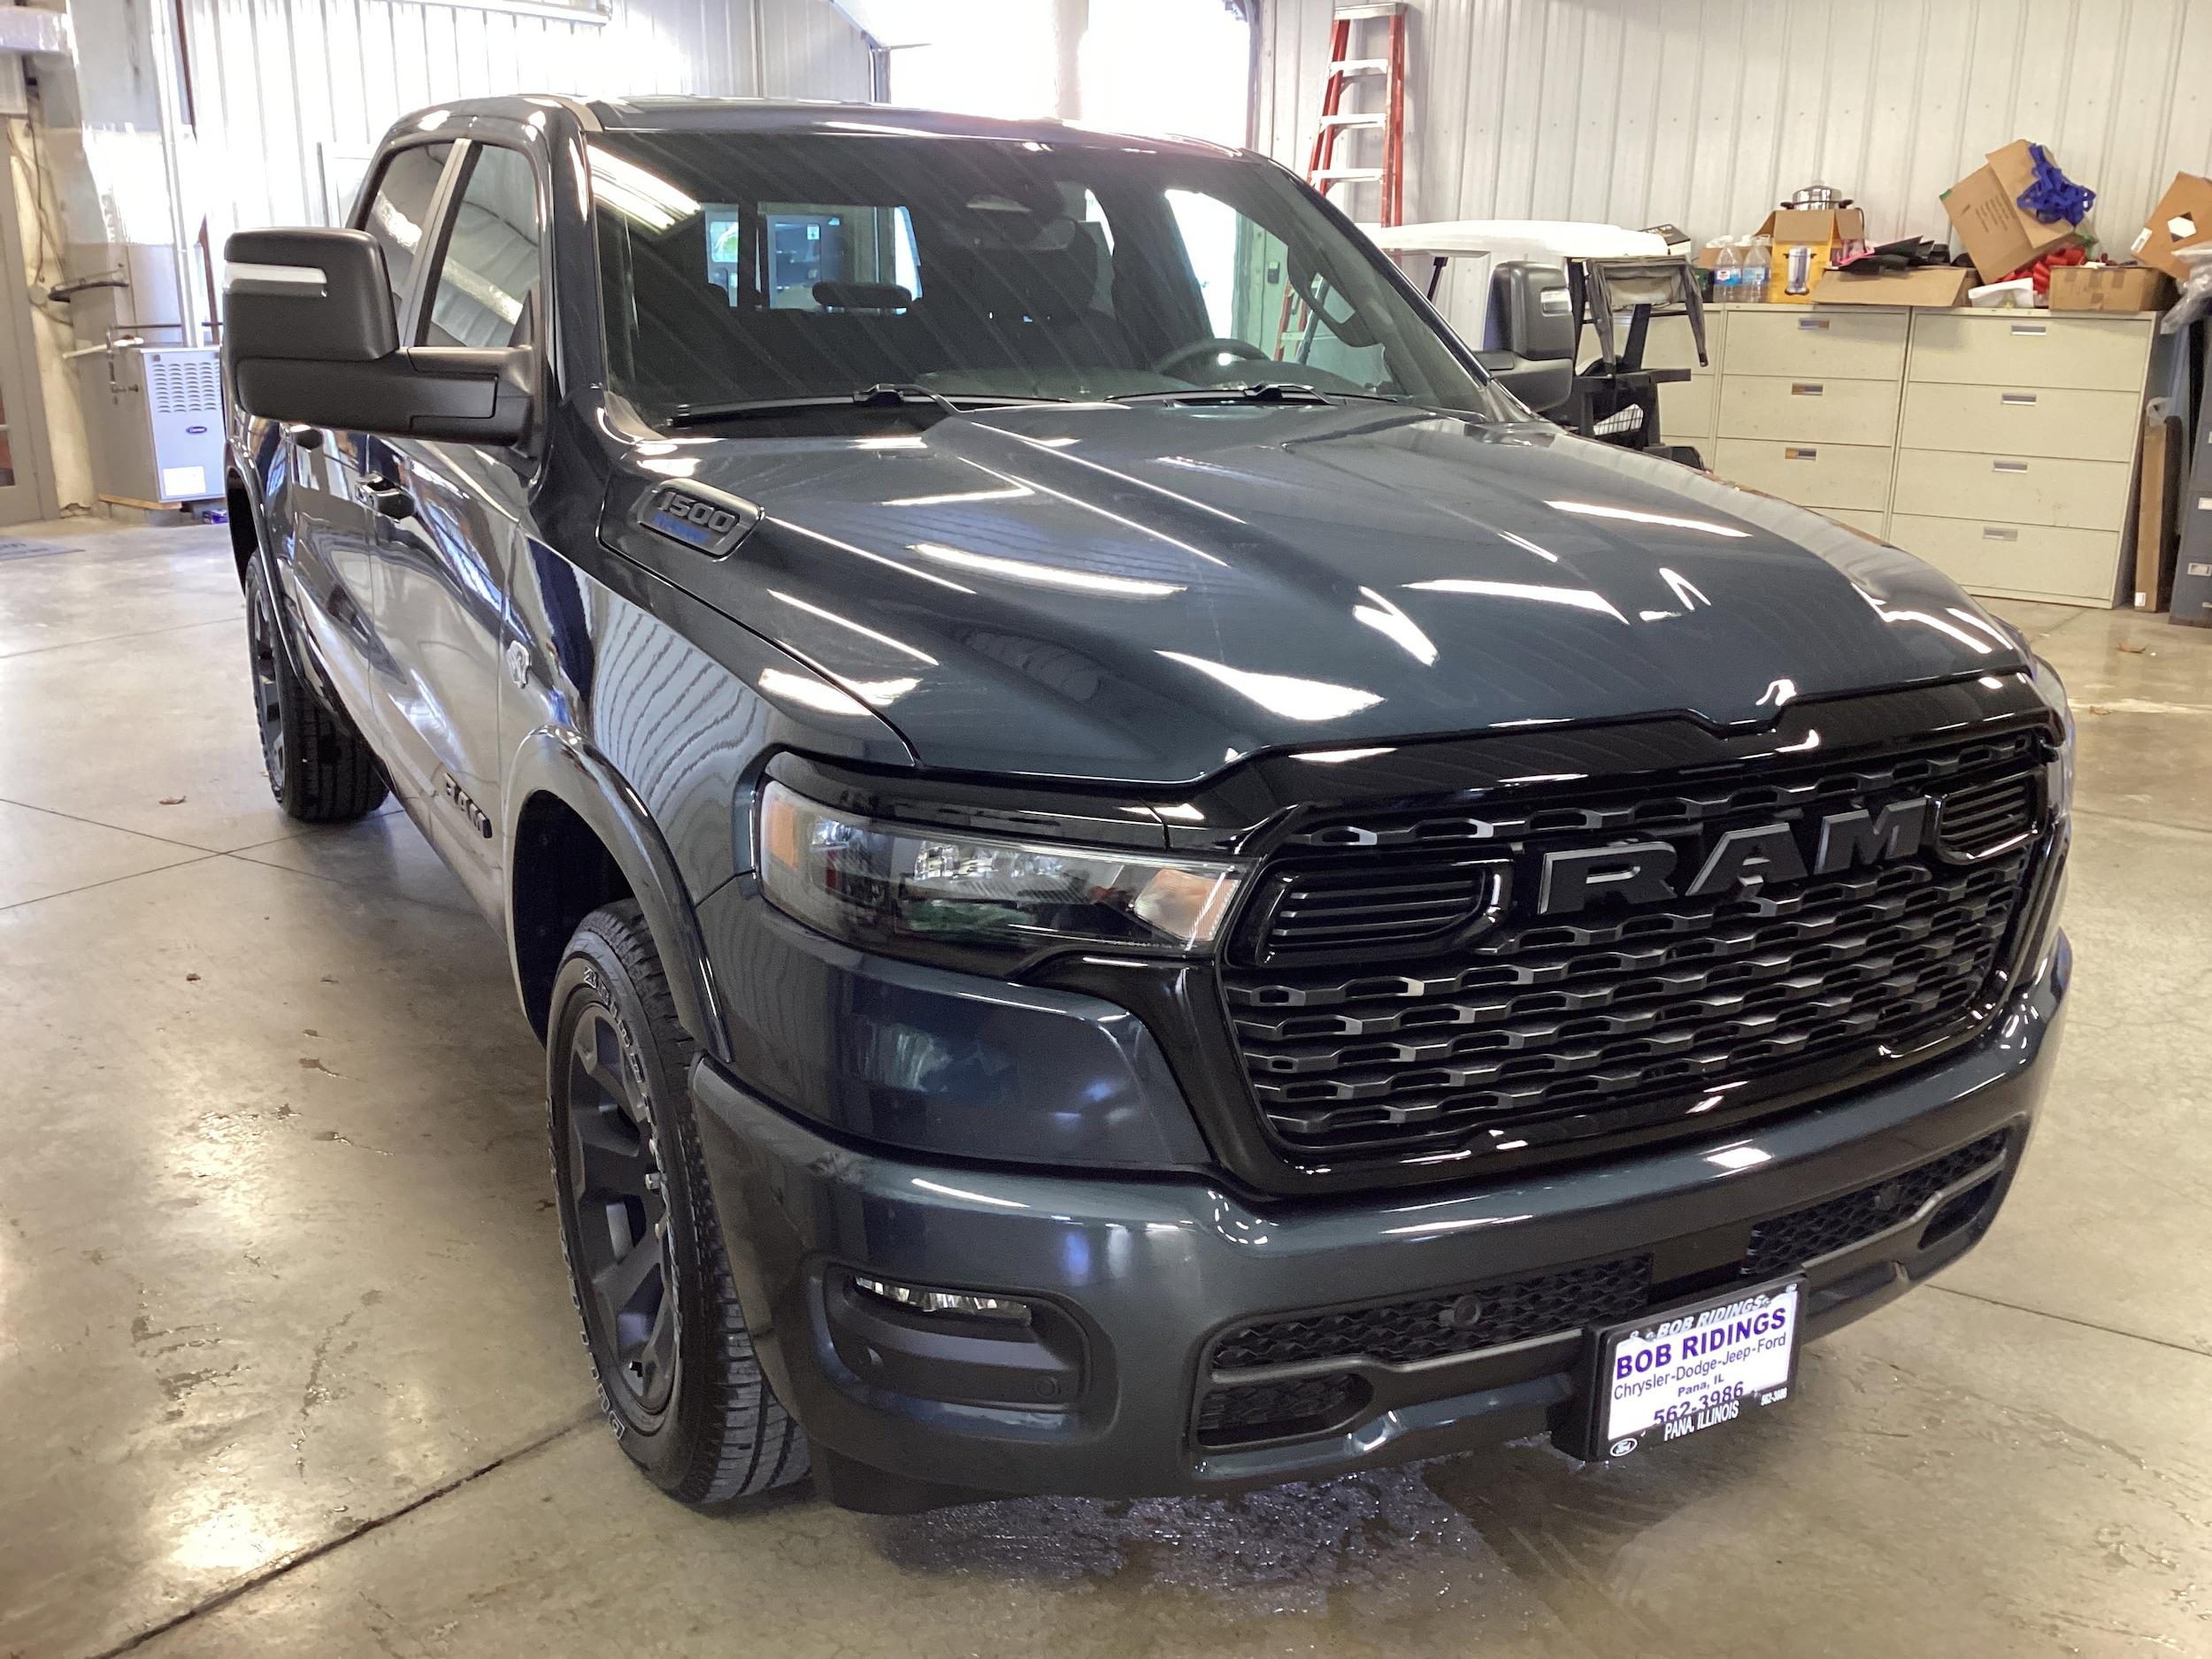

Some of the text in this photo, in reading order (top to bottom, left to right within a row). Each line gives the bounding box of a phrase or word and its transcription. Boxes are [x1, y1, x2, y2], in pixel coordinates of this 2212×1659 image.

[657, 491, 736, 533] 1500
[443, 772, 492, 838] RAM
[1537, 796, 1929, 916] RAM
[1656, 1294, 1765, 1340] BOB RIDINGS
[1613, 1332, 1786, 1401] Chrysler-Dodge-Jeep-Ford
[1616, 1307, 1786, 1380] BOB RIDINGS
[1654, 1380, 1744, 1425] 562-3986
[1678, 1373, 1724, 1398] Pana, IL
[1697, 1400, 1740, 1431] ILLINOIS
